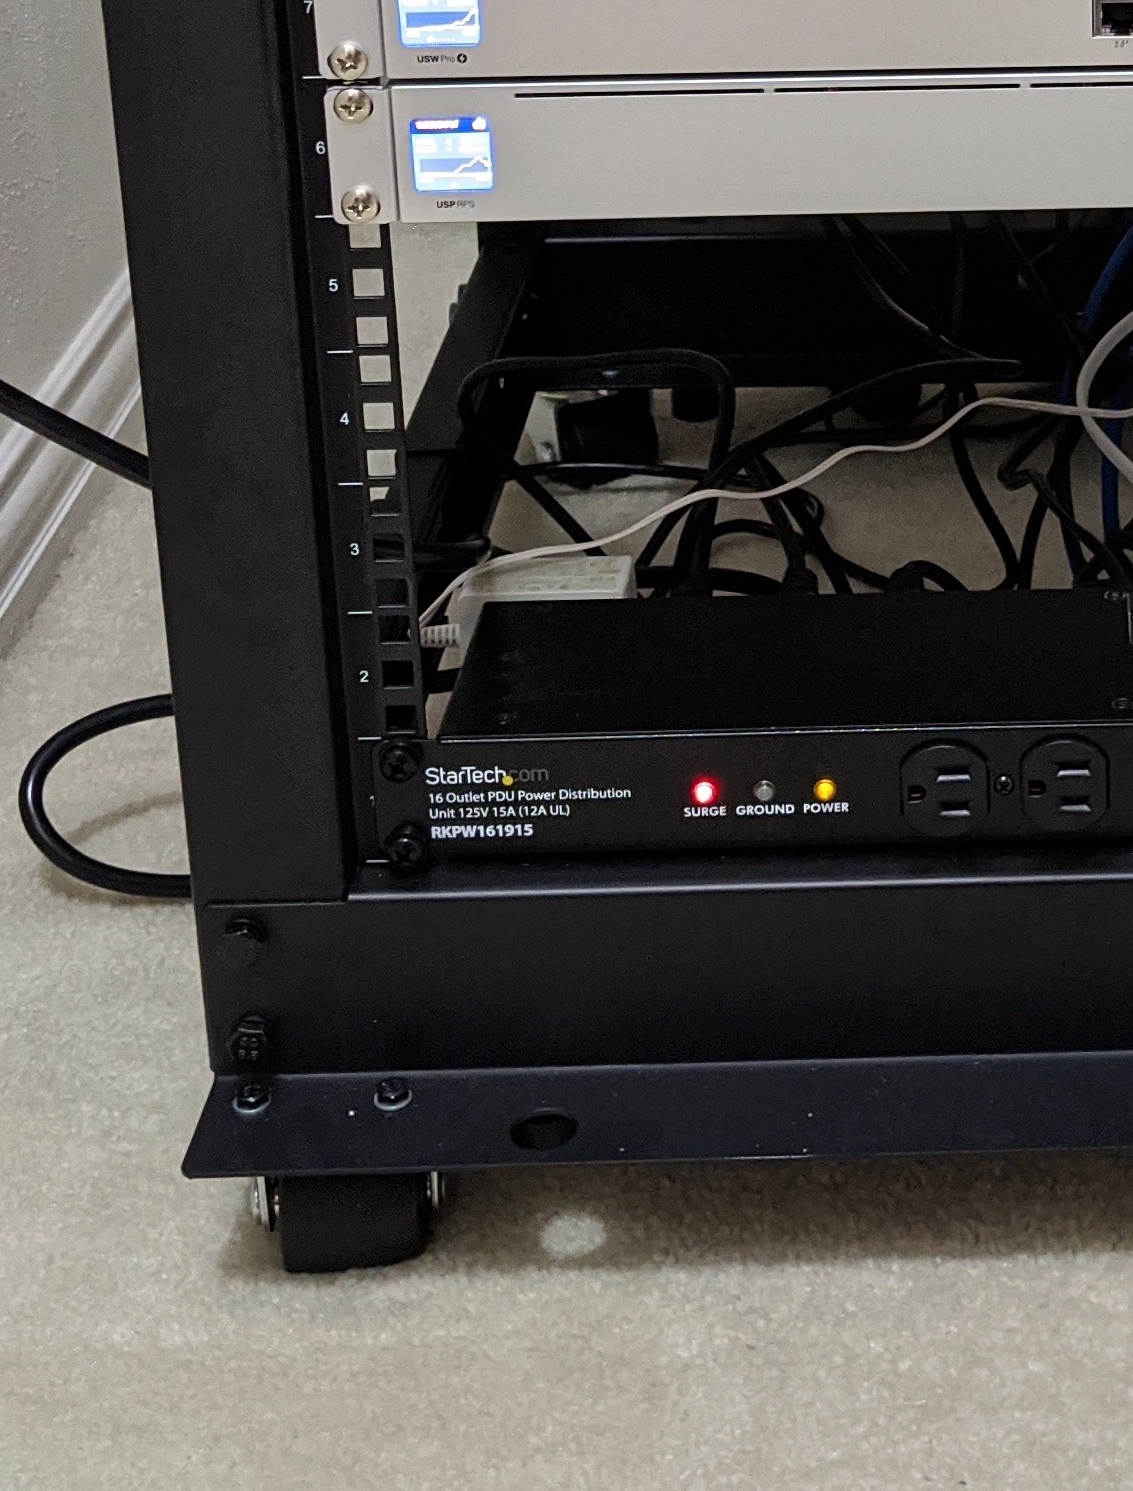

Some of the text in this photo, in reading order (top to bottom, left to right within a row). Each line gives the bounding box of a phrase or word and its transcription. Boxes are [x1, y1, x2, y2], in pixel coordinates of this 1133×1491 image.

[303, 0, 313, 14] 7
[417, 54, 456, 63] USW Pro
[315, 140, 326, 155] 6
[436, 200, 456, 209] USP
[328, 278, 339, 293] 5
[339, 412, 350, 425] 4
[349, 542, 360, 556] 3
[359, 670, 369, 683] 2
[425, 766, 549, 786] StarTech.com
[429, 787, 631, 804] 16 Outlet PDU Power Distribution
[429, 804, 571, 819] Unit 125V 15A (12A UL)
[683, 802, 850, 818] SURGE GROUND POWER
[431, 824, 534, 839] RKPW161915
